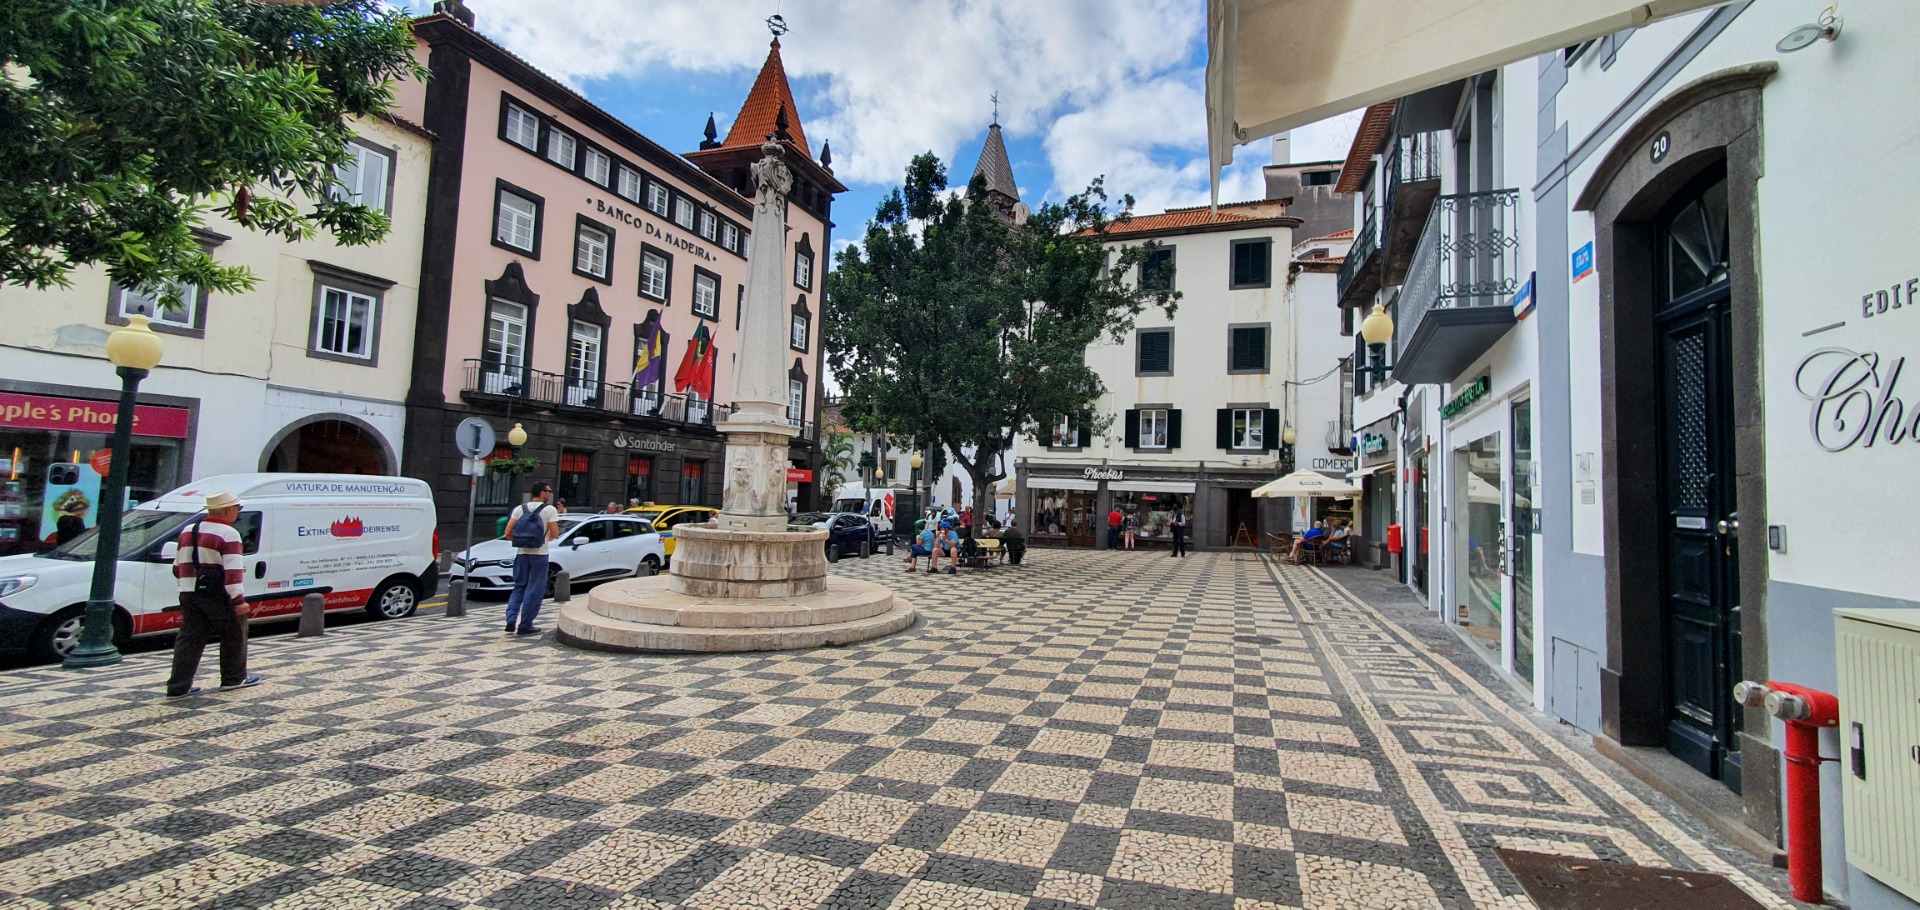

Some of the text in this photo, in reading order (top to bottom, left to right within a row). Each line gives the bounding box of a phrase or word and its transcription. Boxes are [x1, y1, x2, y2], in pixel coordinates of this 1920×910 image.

[1653, 136, 1667, 159] 20
[596, 199, 711, 262] BANCO DA MADEIRA
[1861, 277, 1919, 319] EDIF
[68, 406, 139, 427] Pho
[628, 436, 676, 452] Santander
[1082, 467, 1124, 480] Phoebus
[286, 483, 405, 494] VIATURA DE MANUTENÇÃO
